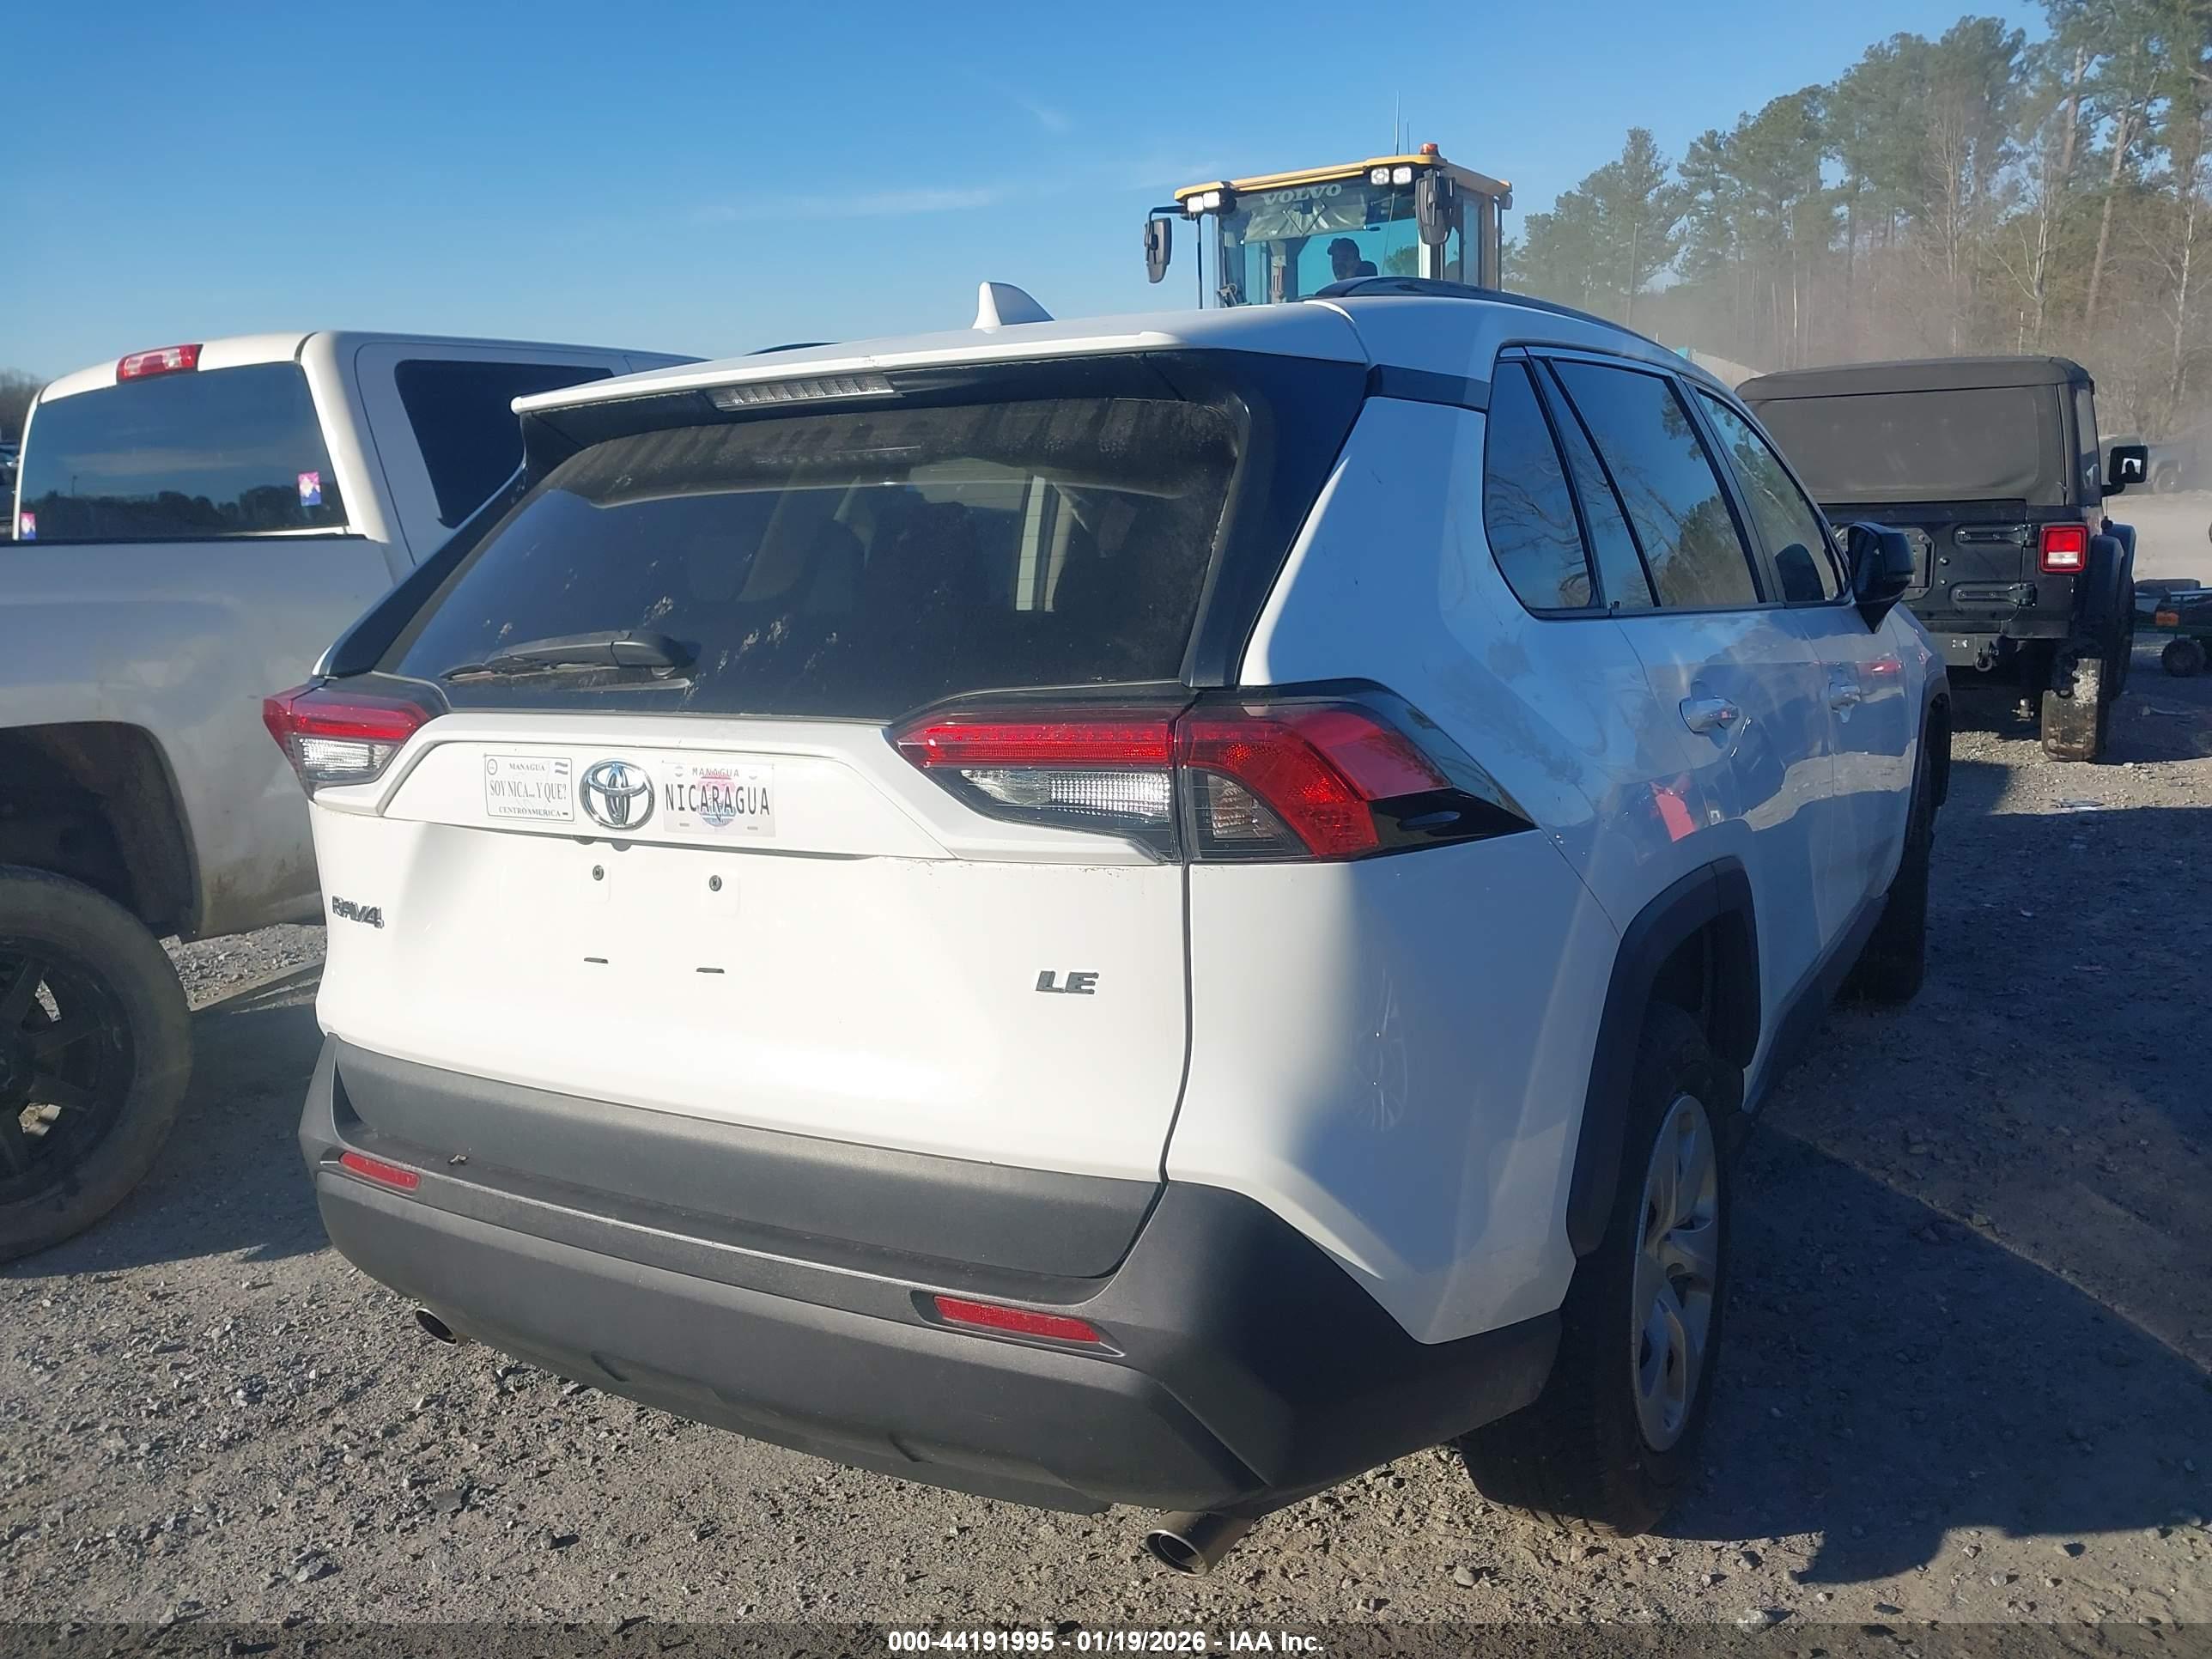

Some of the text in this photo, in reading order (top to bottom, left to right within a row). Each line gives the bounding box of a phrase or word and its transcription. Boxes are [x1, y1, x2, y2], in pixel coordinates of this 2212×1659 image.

[1261, 183, 1342, 206] VOLVO
[509, 763, 546, 771] MANAGUA
[692, 767, 739, 777] MANAGUA
[489, 780, 507, 797] SOY
[536, 782, 544, 799] Y
[544, 782, 567, 803] QUE?
[665, 783, 770, 816] NICARAGUA
[498, 805, 562, 817] CENTROAMERICA
[331, 895, 385, 928] RAV4
[1036, 969, 1100, 994] LE
